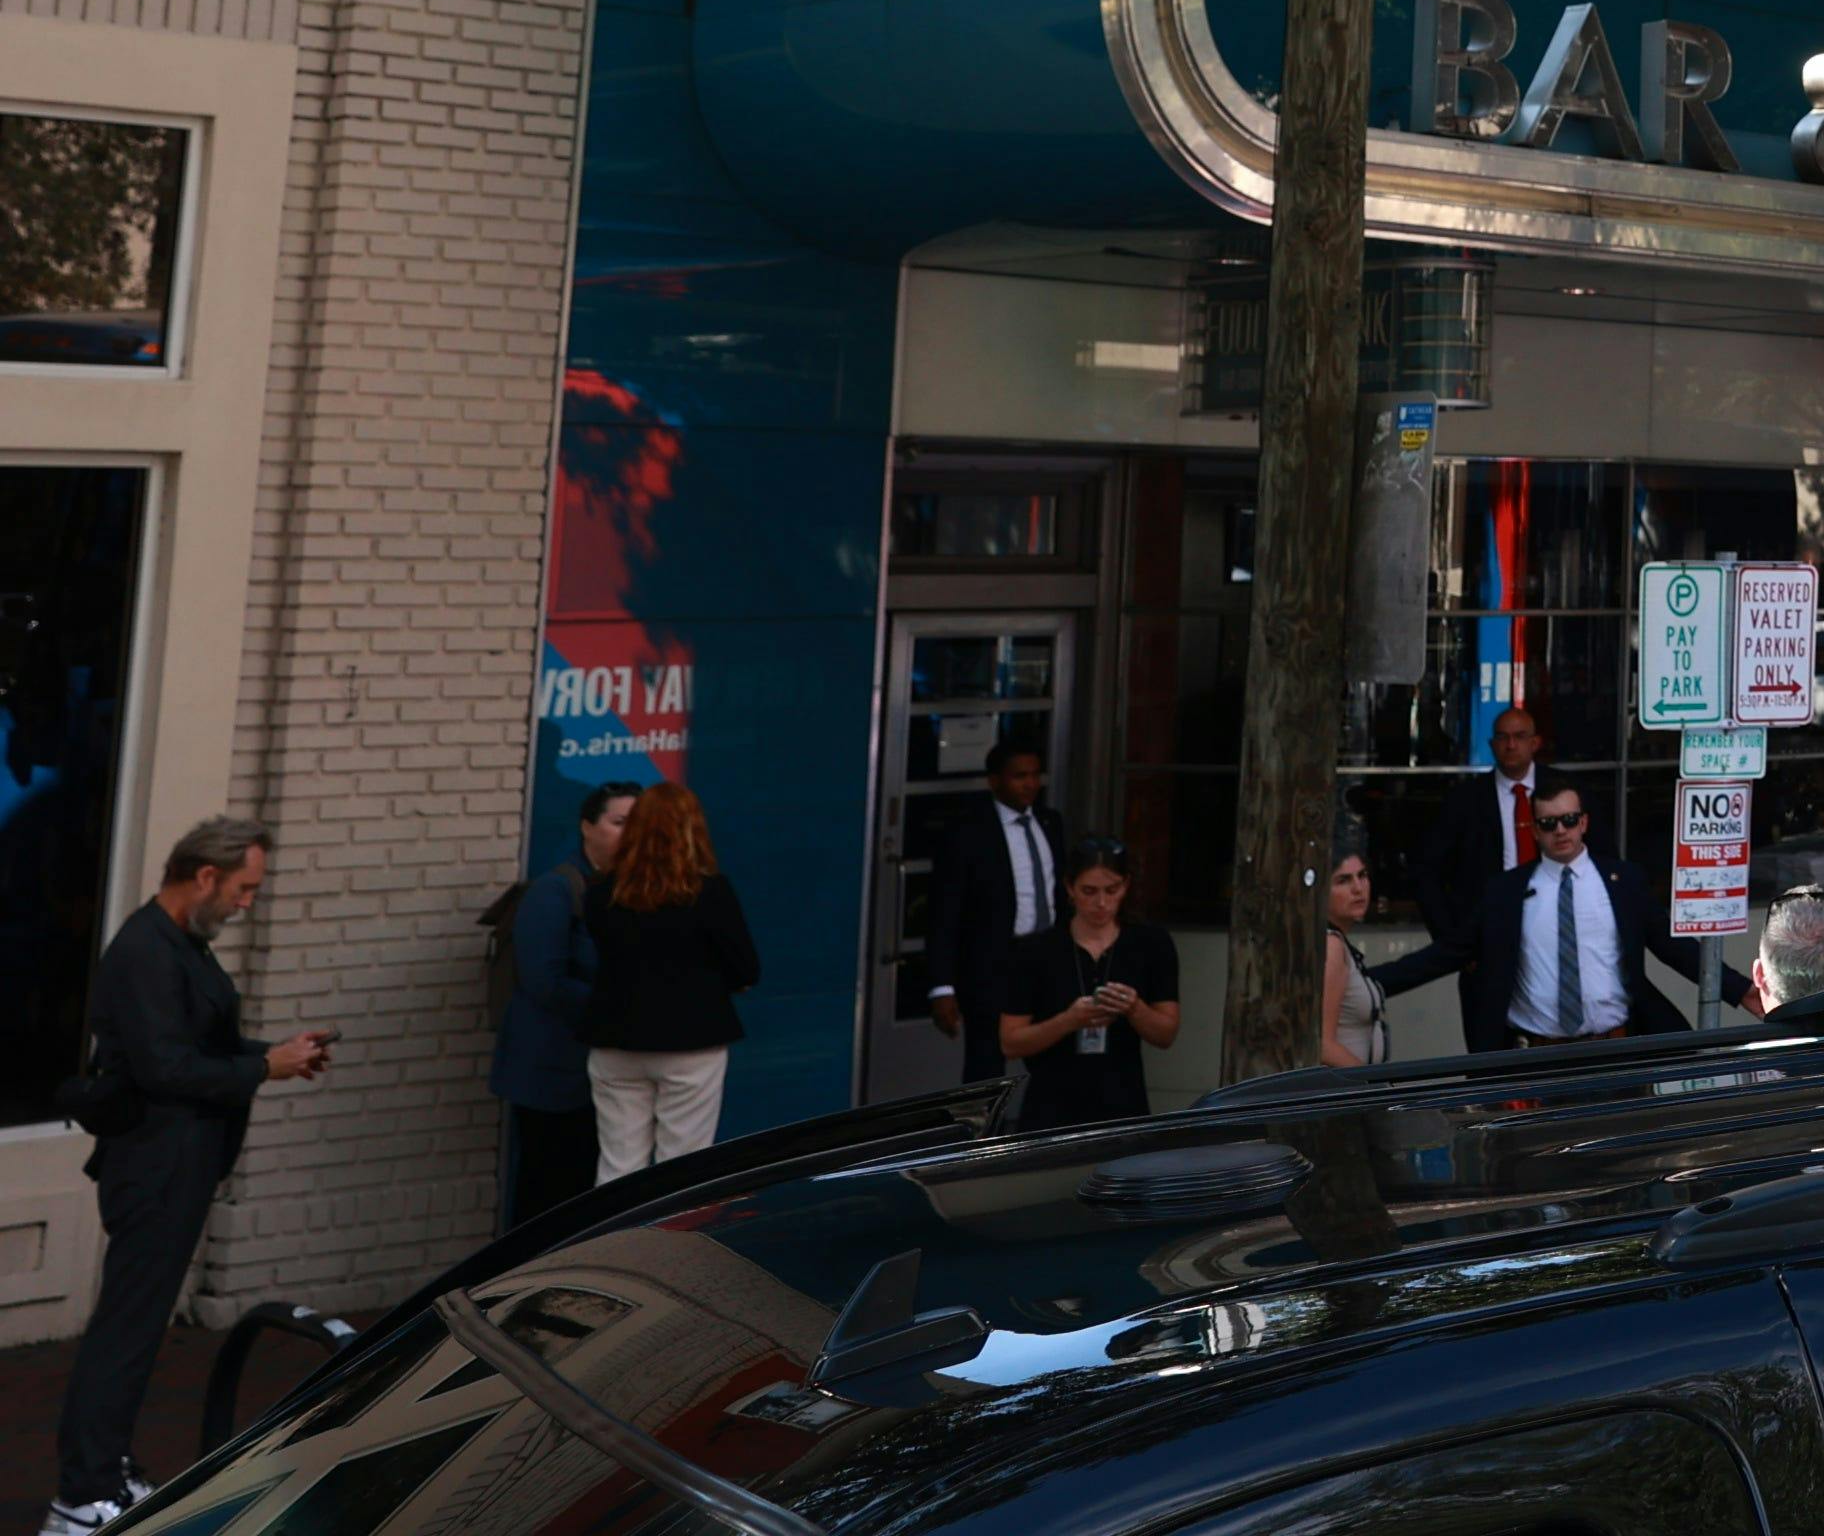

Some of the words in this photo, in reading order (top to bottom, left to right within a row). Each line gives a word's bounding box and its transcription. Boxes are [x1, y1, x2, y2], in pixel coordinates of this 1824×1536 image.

[1743, 582, 1811, 603] RESERVED
[1750, 609, 1802, 630] VALET
[1666, 626, 1697, 647] PAY
[1744, 637, 1805, 658] PARKING
[1673, 650, 1692, 671] TO
[1754, 665, 1794, 686] ONLY
[1661, 676, 1702, 698] PARK
[1685, 734, 1733, 748] REMEMBER
[1738, 734, 1762, 748] YOUR
[1701, 754, 1731, 768] SPACE
[1691, 794, 1730, 819] NO
[1690, 821, 1743, 835] PARKING
[1690, 845, 1722, 860] THIS
